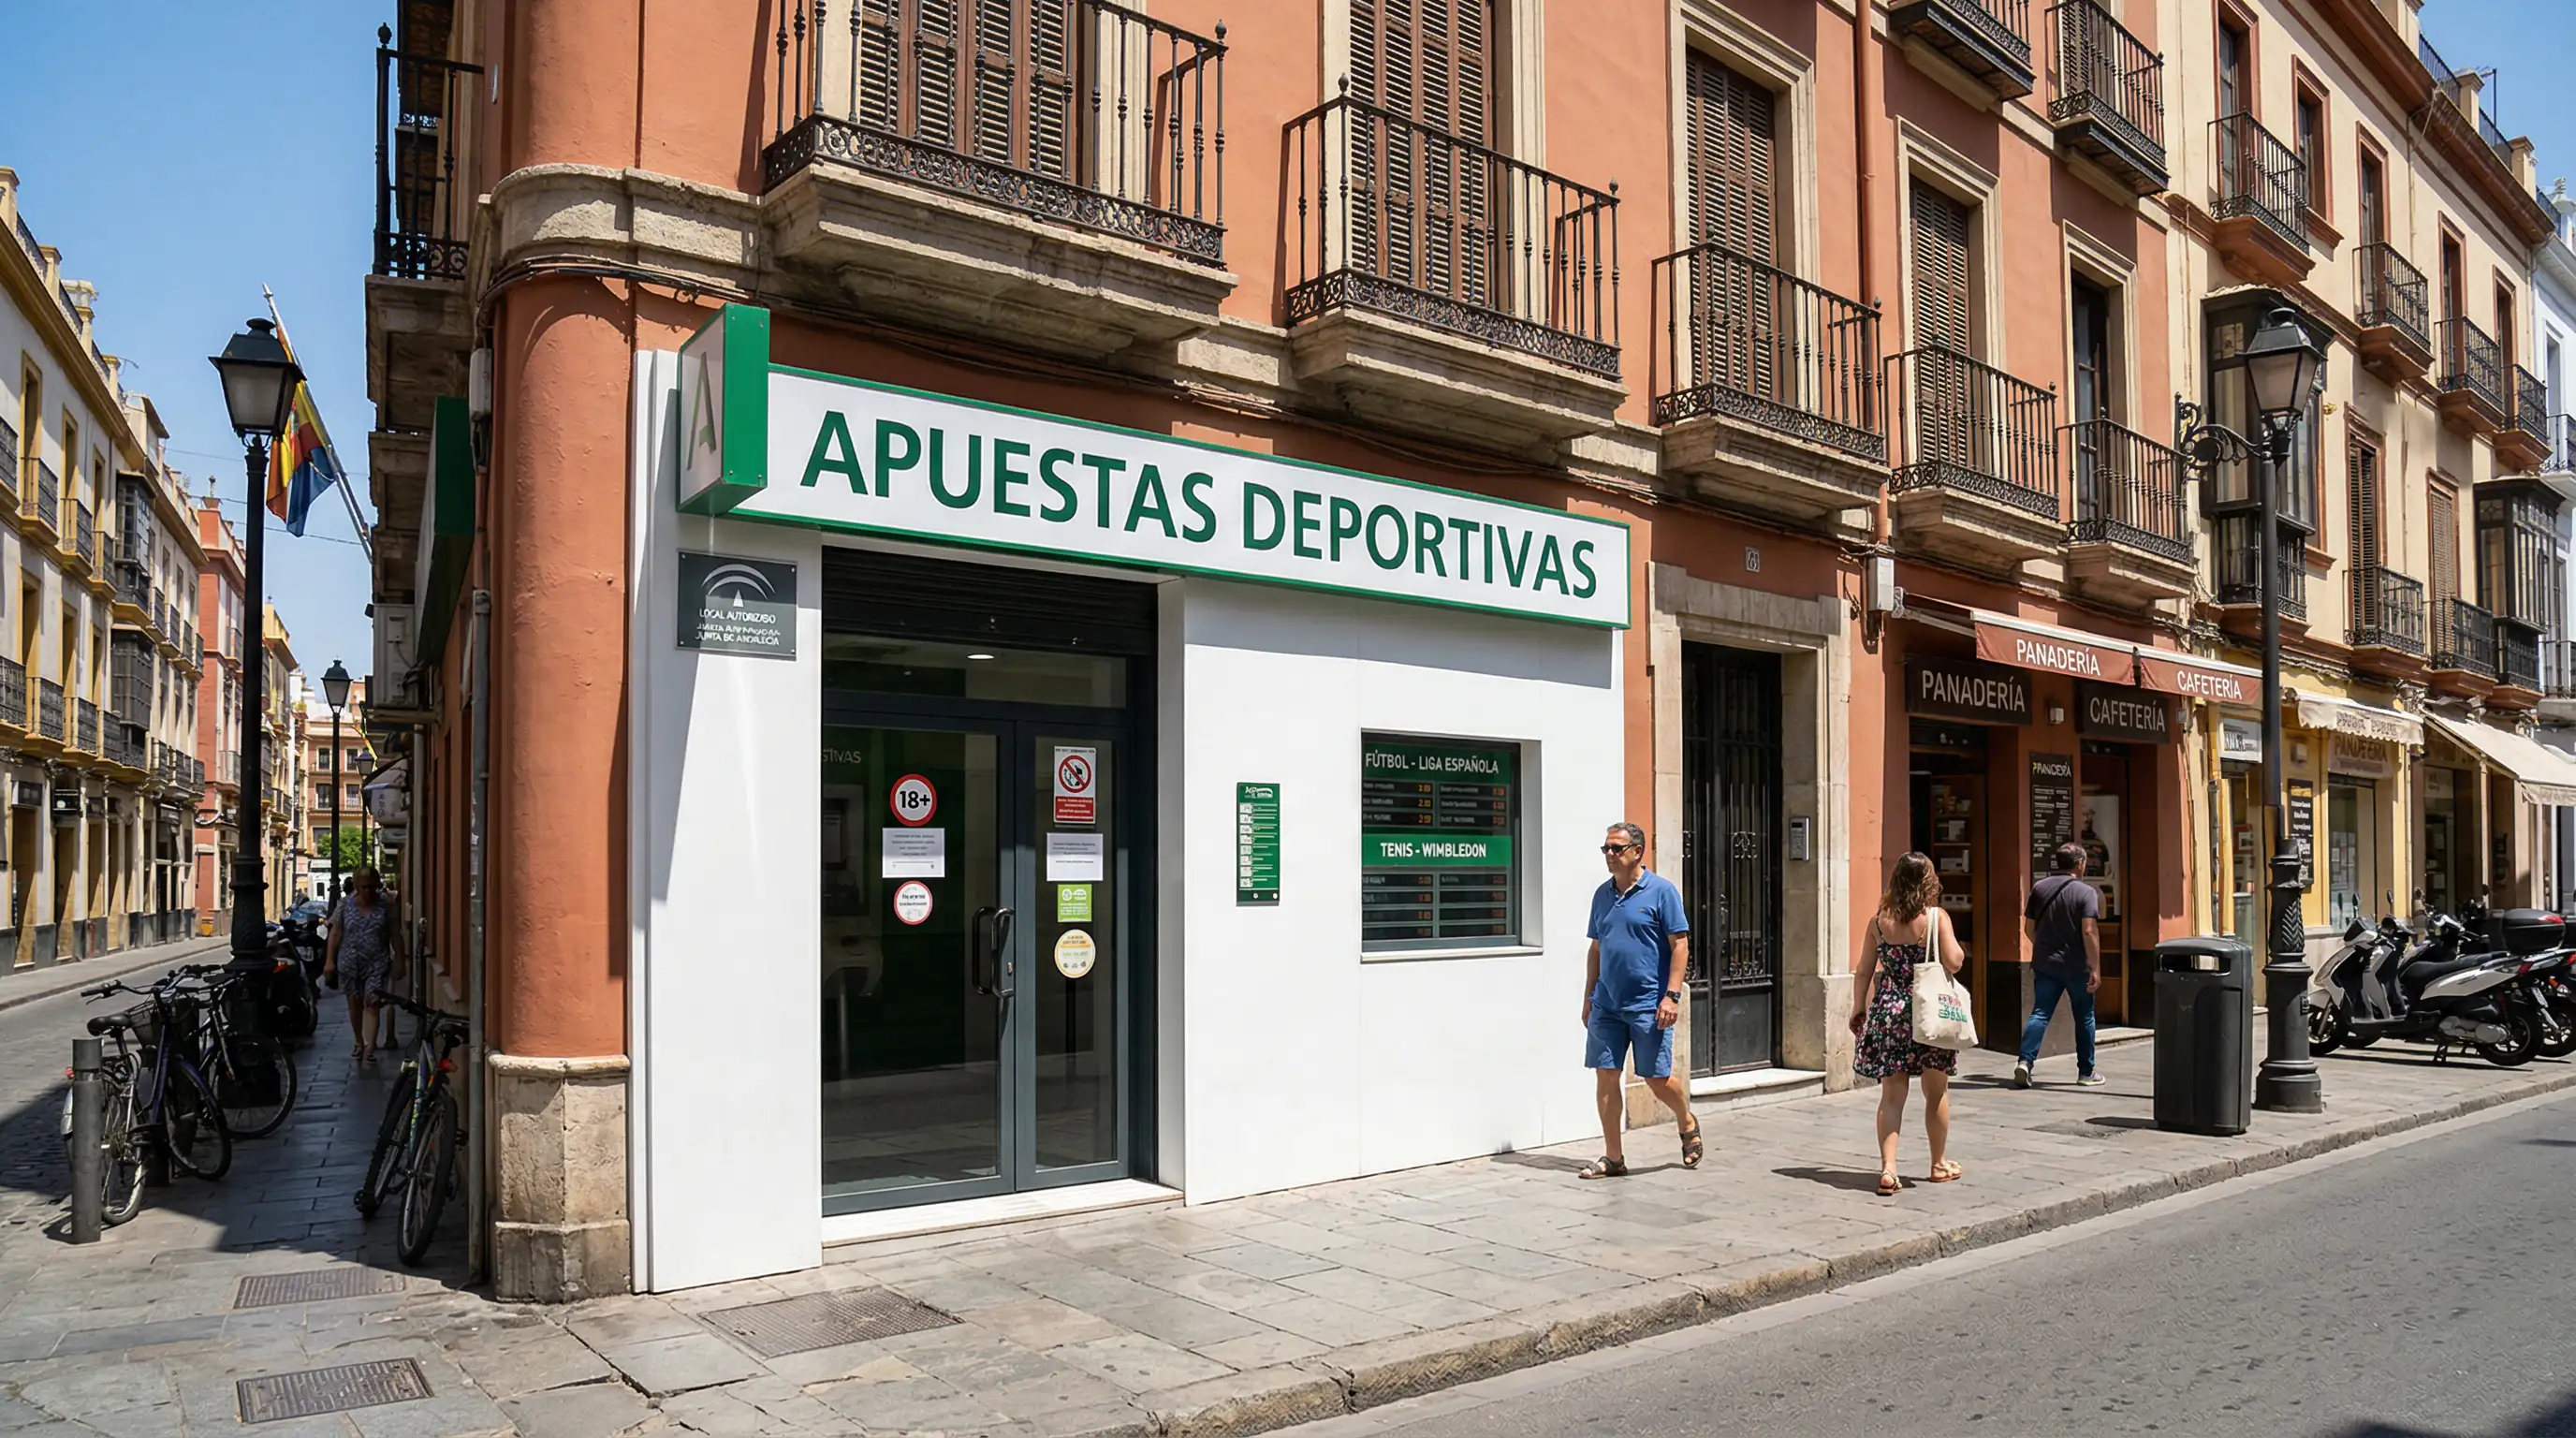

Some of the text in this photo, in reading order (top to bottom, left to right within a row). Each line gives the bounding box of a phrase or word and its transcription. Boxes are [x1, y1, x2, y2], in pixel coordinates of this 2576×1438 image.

[799, 410, 1598, 599] APUESTAS DEPORTIVAS
[699, 609, 724, 620] LOCAL
[2016, 638, 2100, 677] PANADERÍA
[1922, 669, 2026, 712] PANADERÍA
[2176, 670, 2243, 700] CAFETERÍA
[2089, 696, 2166, 732] CAFETERÍA
[1366, 750, 1409, 769] FÚTBOL
[1419, 756, 1442, 771] LIGA
[1445, 756, 1499, 773] ESPAÑOLA
[900, 790, 930, 809] 18+
[1380, 843, 1413, 858] TENIS
[1422, 843, 1486, 858] WIMBLEDON
